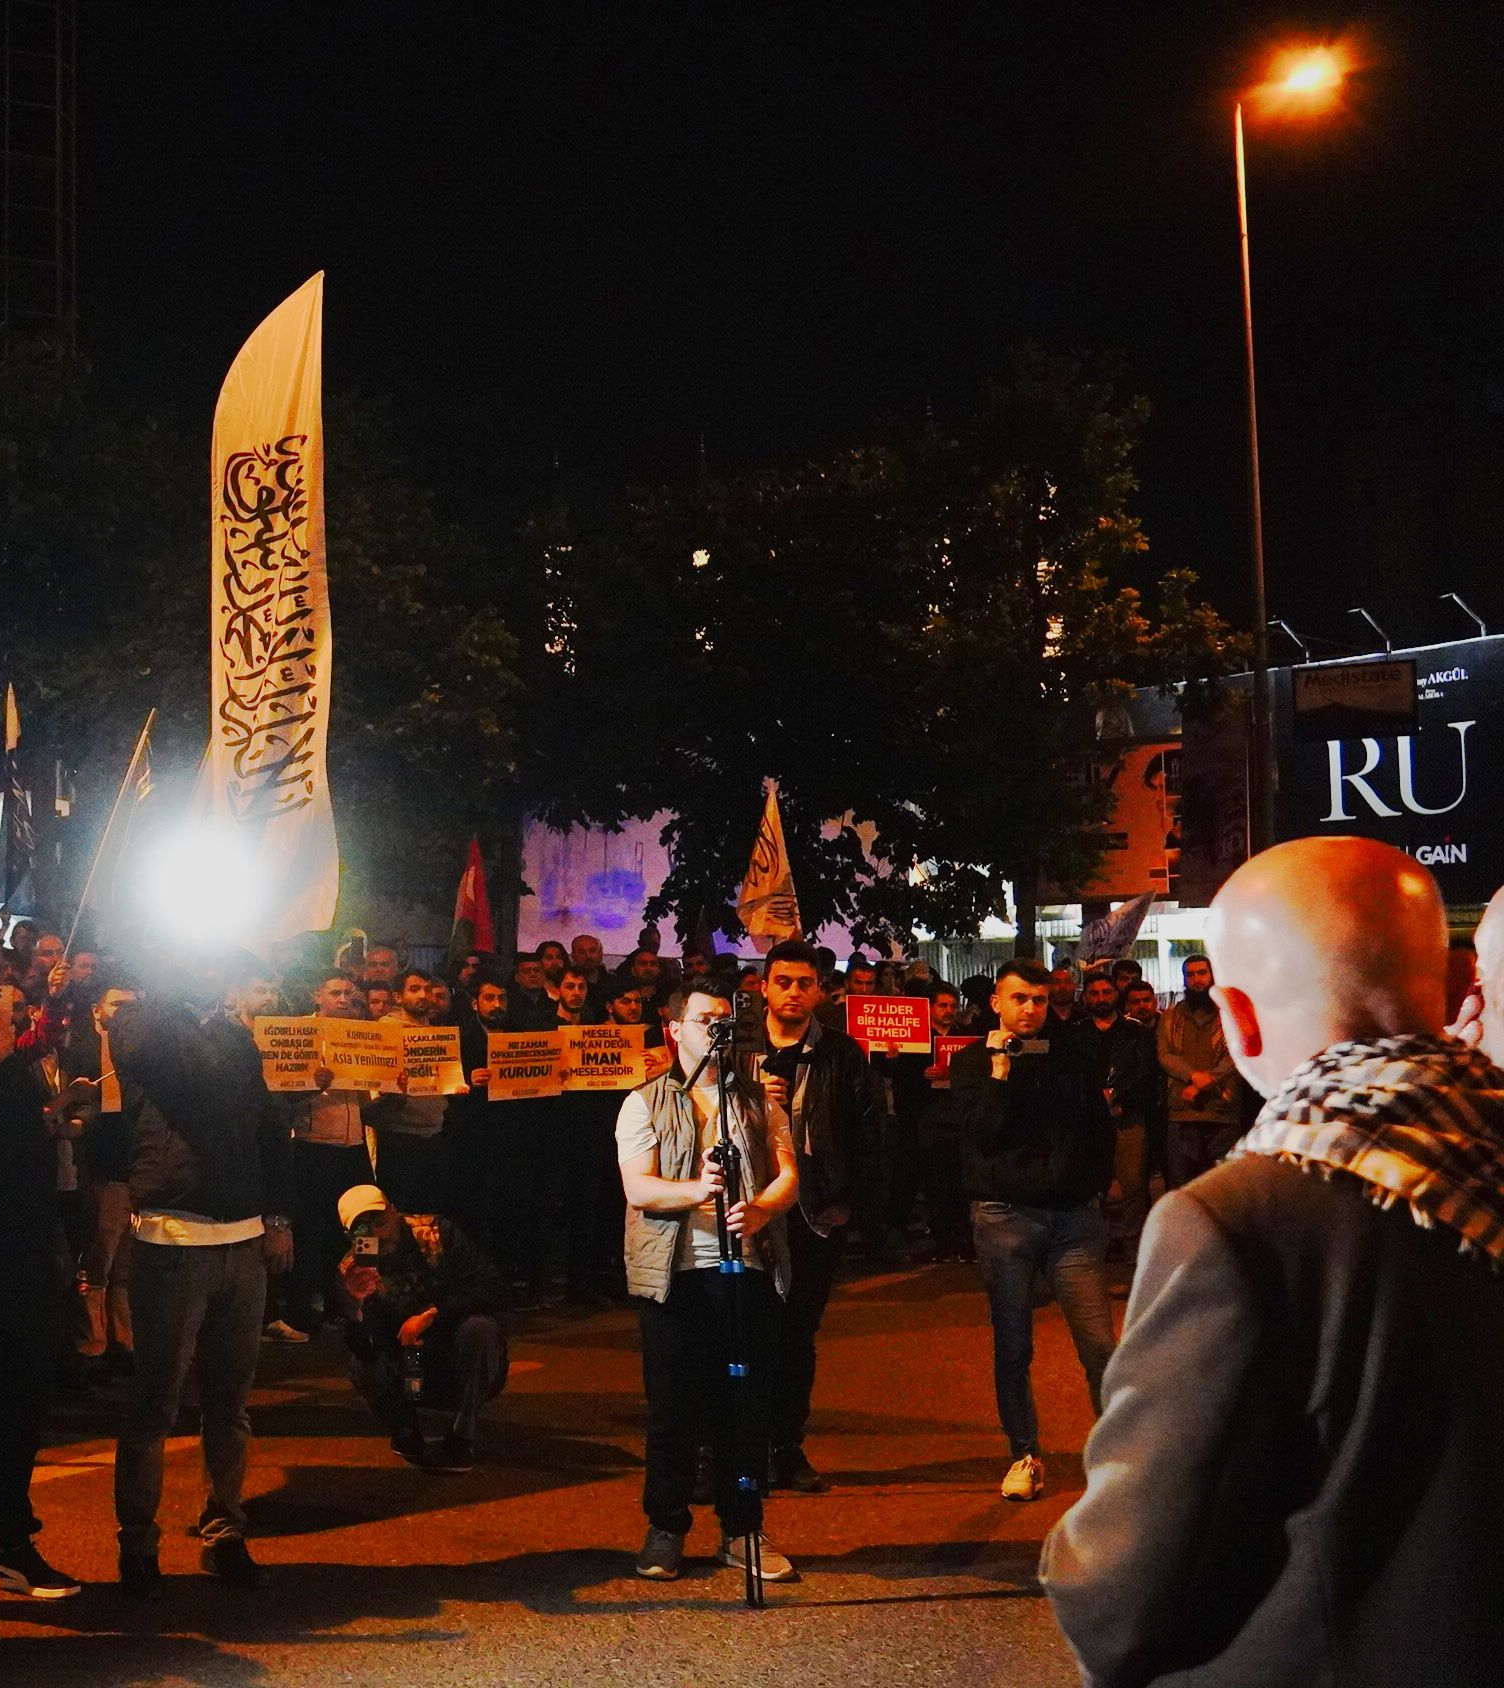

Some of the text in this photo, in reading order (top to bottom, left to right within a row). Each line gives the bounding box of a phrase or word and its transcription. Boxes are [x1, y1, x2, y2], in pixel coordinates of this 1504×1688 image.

[1320, 720, 1476, 822] RU
[863, 1003, 913, 1015] 57 LİDER
[857, 1015, 920, 1028] BİR HALİFE
[582, 1029, 621, 1038] MESELE
[866, 1027, 911, 1038] ETMEDİ
[570, 1037, 633, 1049] İMKAN DEĞİL
[281, 1051, 292, 1060] DE
[333, 1052, 352, 1065] Asla
[581, 1049, 622, 1066] İMAN
[499, 1065, 553, 1079] KURUDU!
